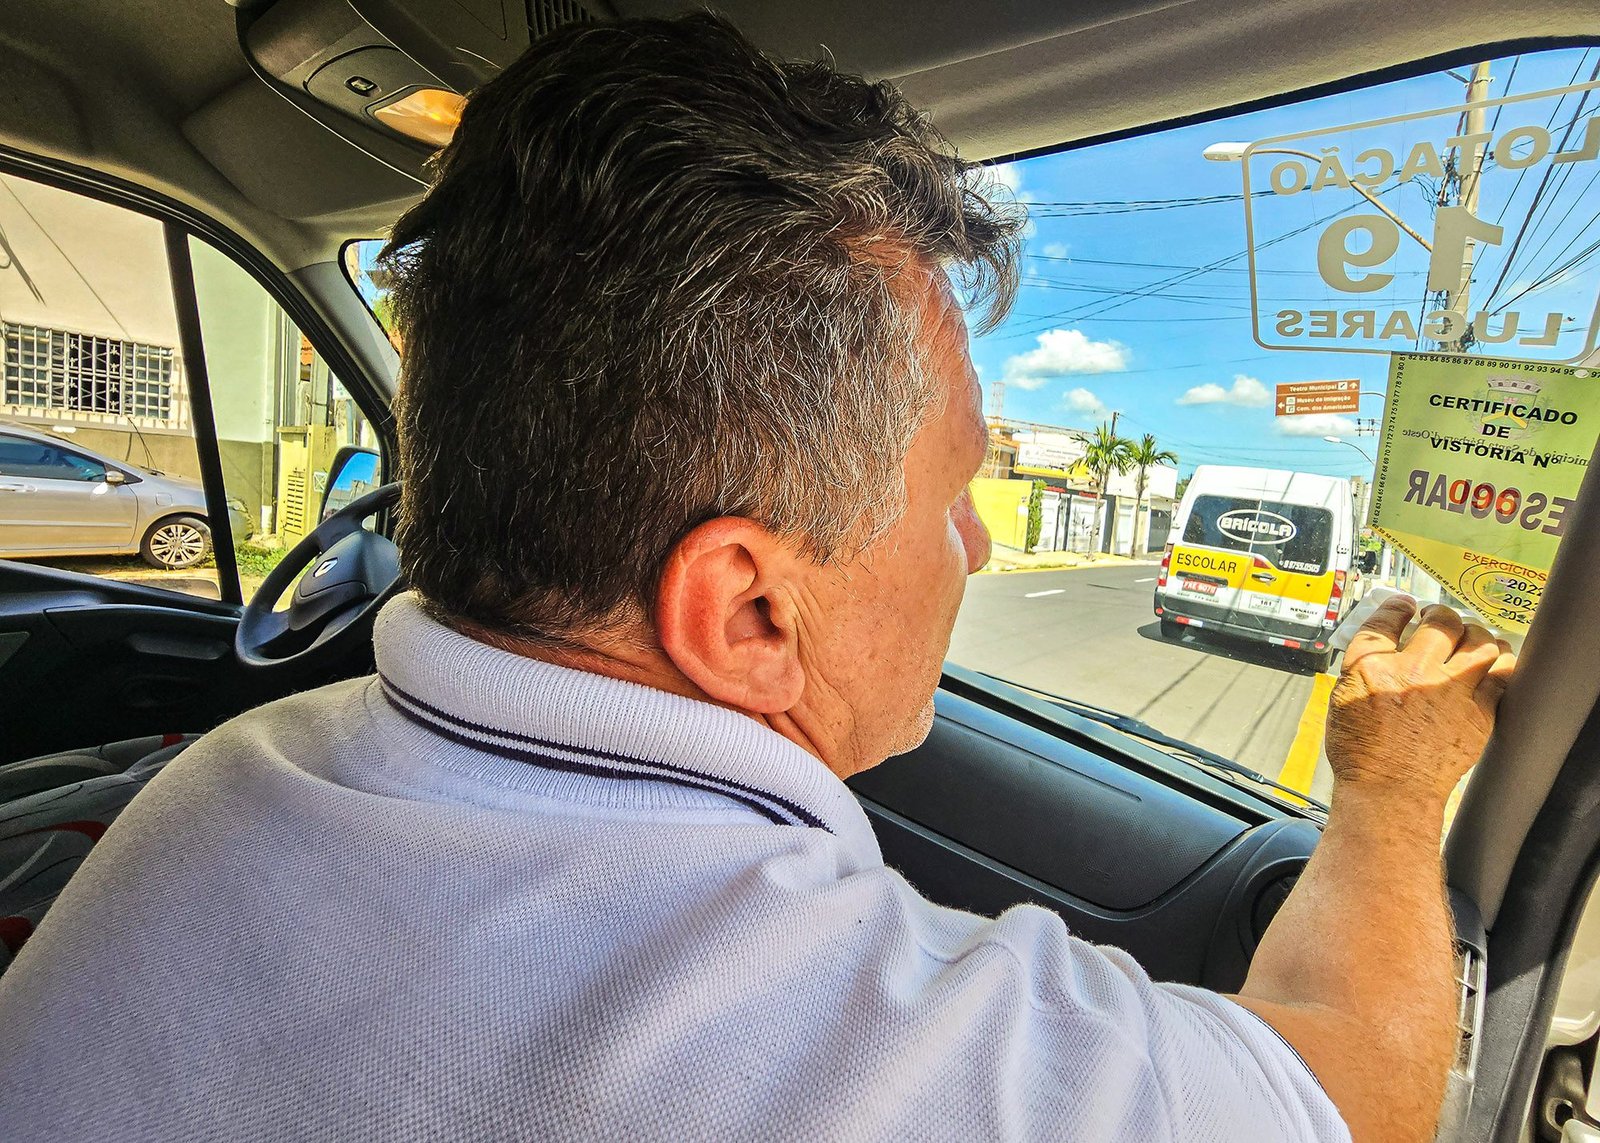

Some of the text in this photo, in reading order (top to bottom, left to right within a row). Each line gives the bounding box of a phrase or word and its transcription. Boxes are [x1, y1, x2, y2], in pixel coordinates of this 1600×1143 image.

[1309, 384, 1337, 392] Municipal
[1429, 394, 1578, 425] CERTIFICADO
[1482, 424, 1511, 439] DE
[1430, 437, 1524, 464] VISTORIA
[1177, 553, 1236, 573] ESCOLAR
